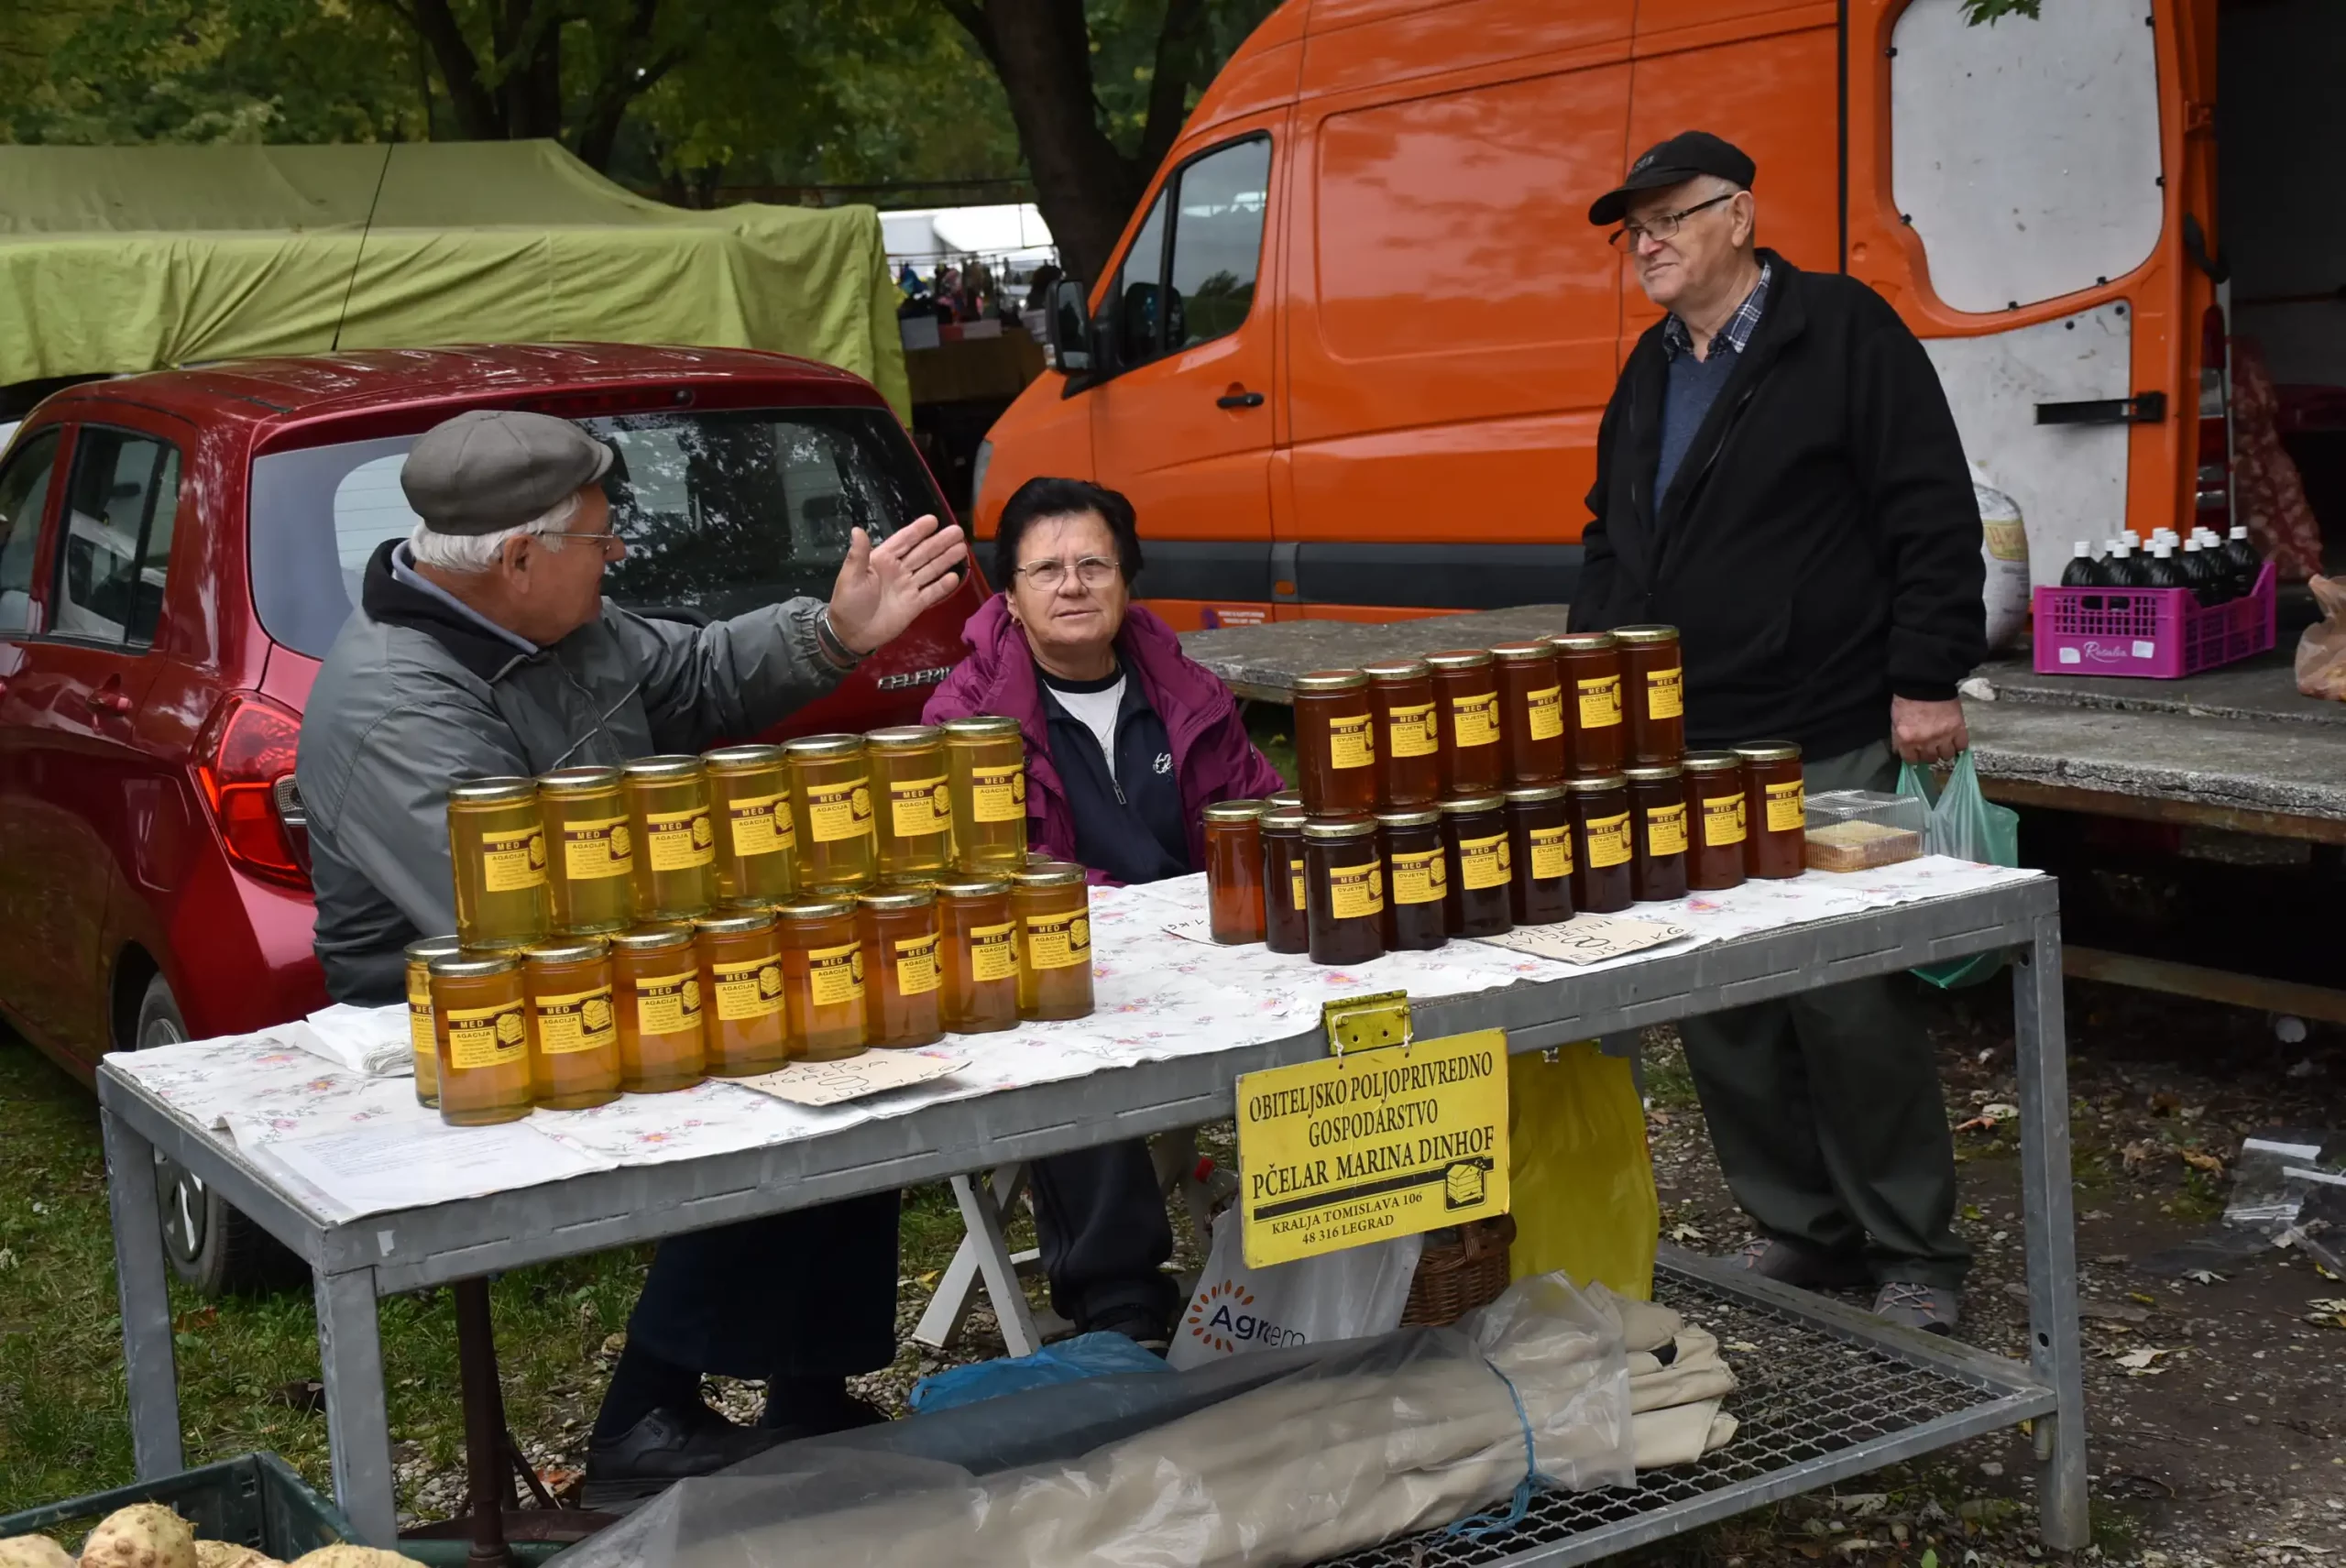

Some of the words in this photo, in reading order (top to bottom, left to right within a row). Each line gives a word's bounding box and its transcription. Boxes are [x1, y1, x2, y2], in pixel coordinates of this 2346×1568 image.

[1538, 697, 1553, 706] MED
[1399, 715, 1420, 723] MED
[820, 794, 842, 803] MED
[903, 790, 925, 799] MED
[1775, 791, 1793, 799] MED
[742, 807, 764, 817] MED
[660, 823, 683, 831] MED
[1596, 826, 1615, 834] MED
[577, 831, 600, 839] MED
[1540, 837, 1558, 845] MED
[497, 842, 520, 850] MED
[1470, 847, 1489, 855] MED
[1401, 861, 1421, 870] MED
[1038, 925, 1060, 933] MED
[1507, 923, 1566, 939] MED
[983, 935, 1004, 944] MED
[907, 948, 928, 958] MED
[821, 958, 843, 966] MED
[726, 972, 749, 981] MED
[649, 987, 673, 996] MED
[546, 1005, 571, 1014] MED
[460, 1020, 484, 1028] MED
[1249, 1079, 1347, 1123] OBITELJSKO
[1351, 1051, 1493, 1102] POLJOPRIVREDNO
[1309, 1099, 1439, 1147] GOSPODARSTVO
[1252, 1159, 1329, 1200] PČELAR
[1335, 1143, 1414, 1181] MARINA
[1418, 1125, 1495, 1165] DINHOF
[1272, 1212, 1321, 1235] KRALJA
[1323, 1198, 1400, 1223] TOMISLAVA
[1403, 1191, 1423, 1205] 106
[1301, 1232, 1316, 1245] 48
[1319, 1225, 1339, 1241] 316
[1342, 1214, 1394, 1237] LEGRAD
